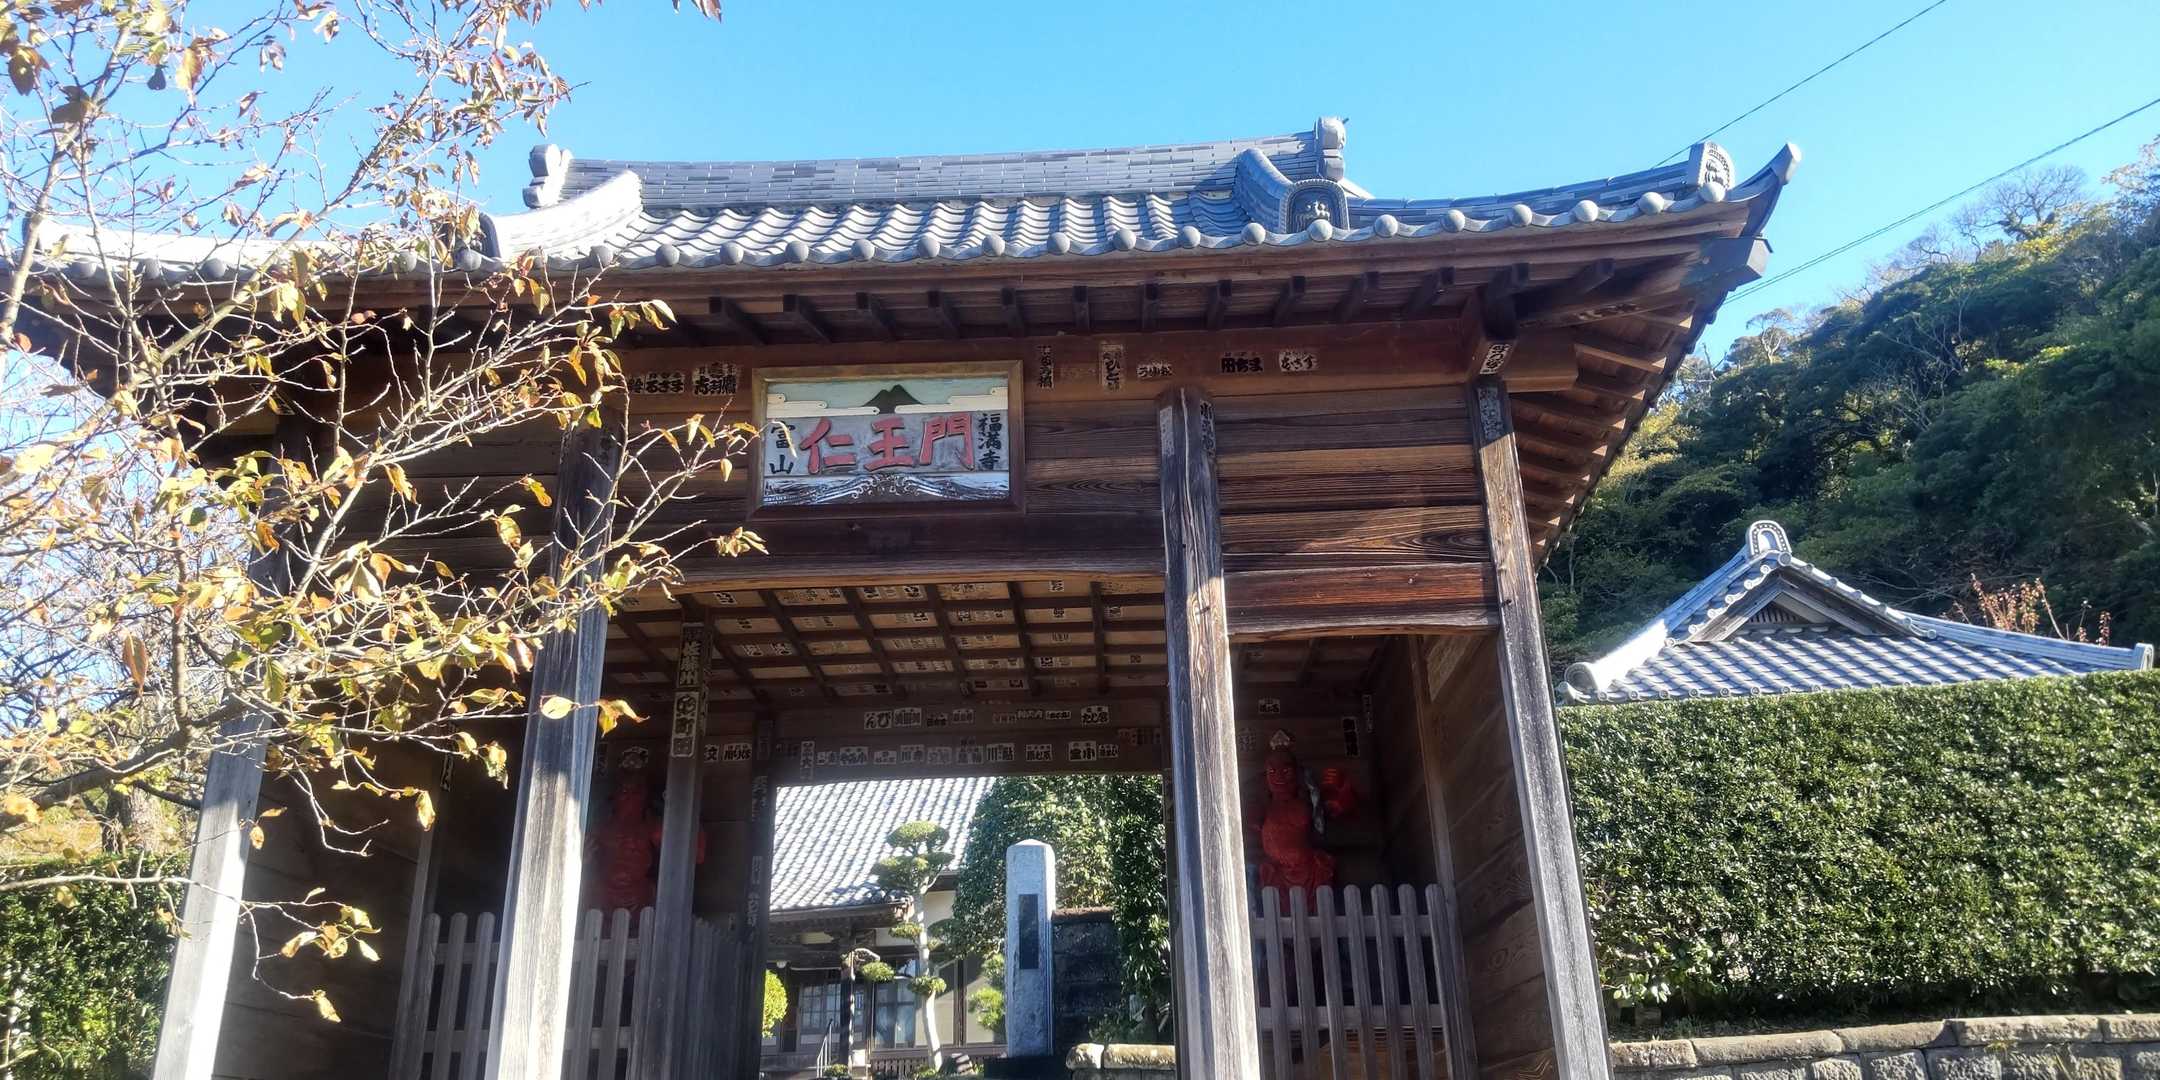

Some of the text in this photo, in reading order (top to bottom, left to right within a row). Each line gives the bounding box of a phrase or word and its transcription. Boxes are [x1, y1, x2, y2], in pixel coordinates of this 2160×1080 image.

[769, 421, 797, 475] 富山
[800, 411, 976, 475] 仁王門
[978, 412, 1002, 471] 福満寺
